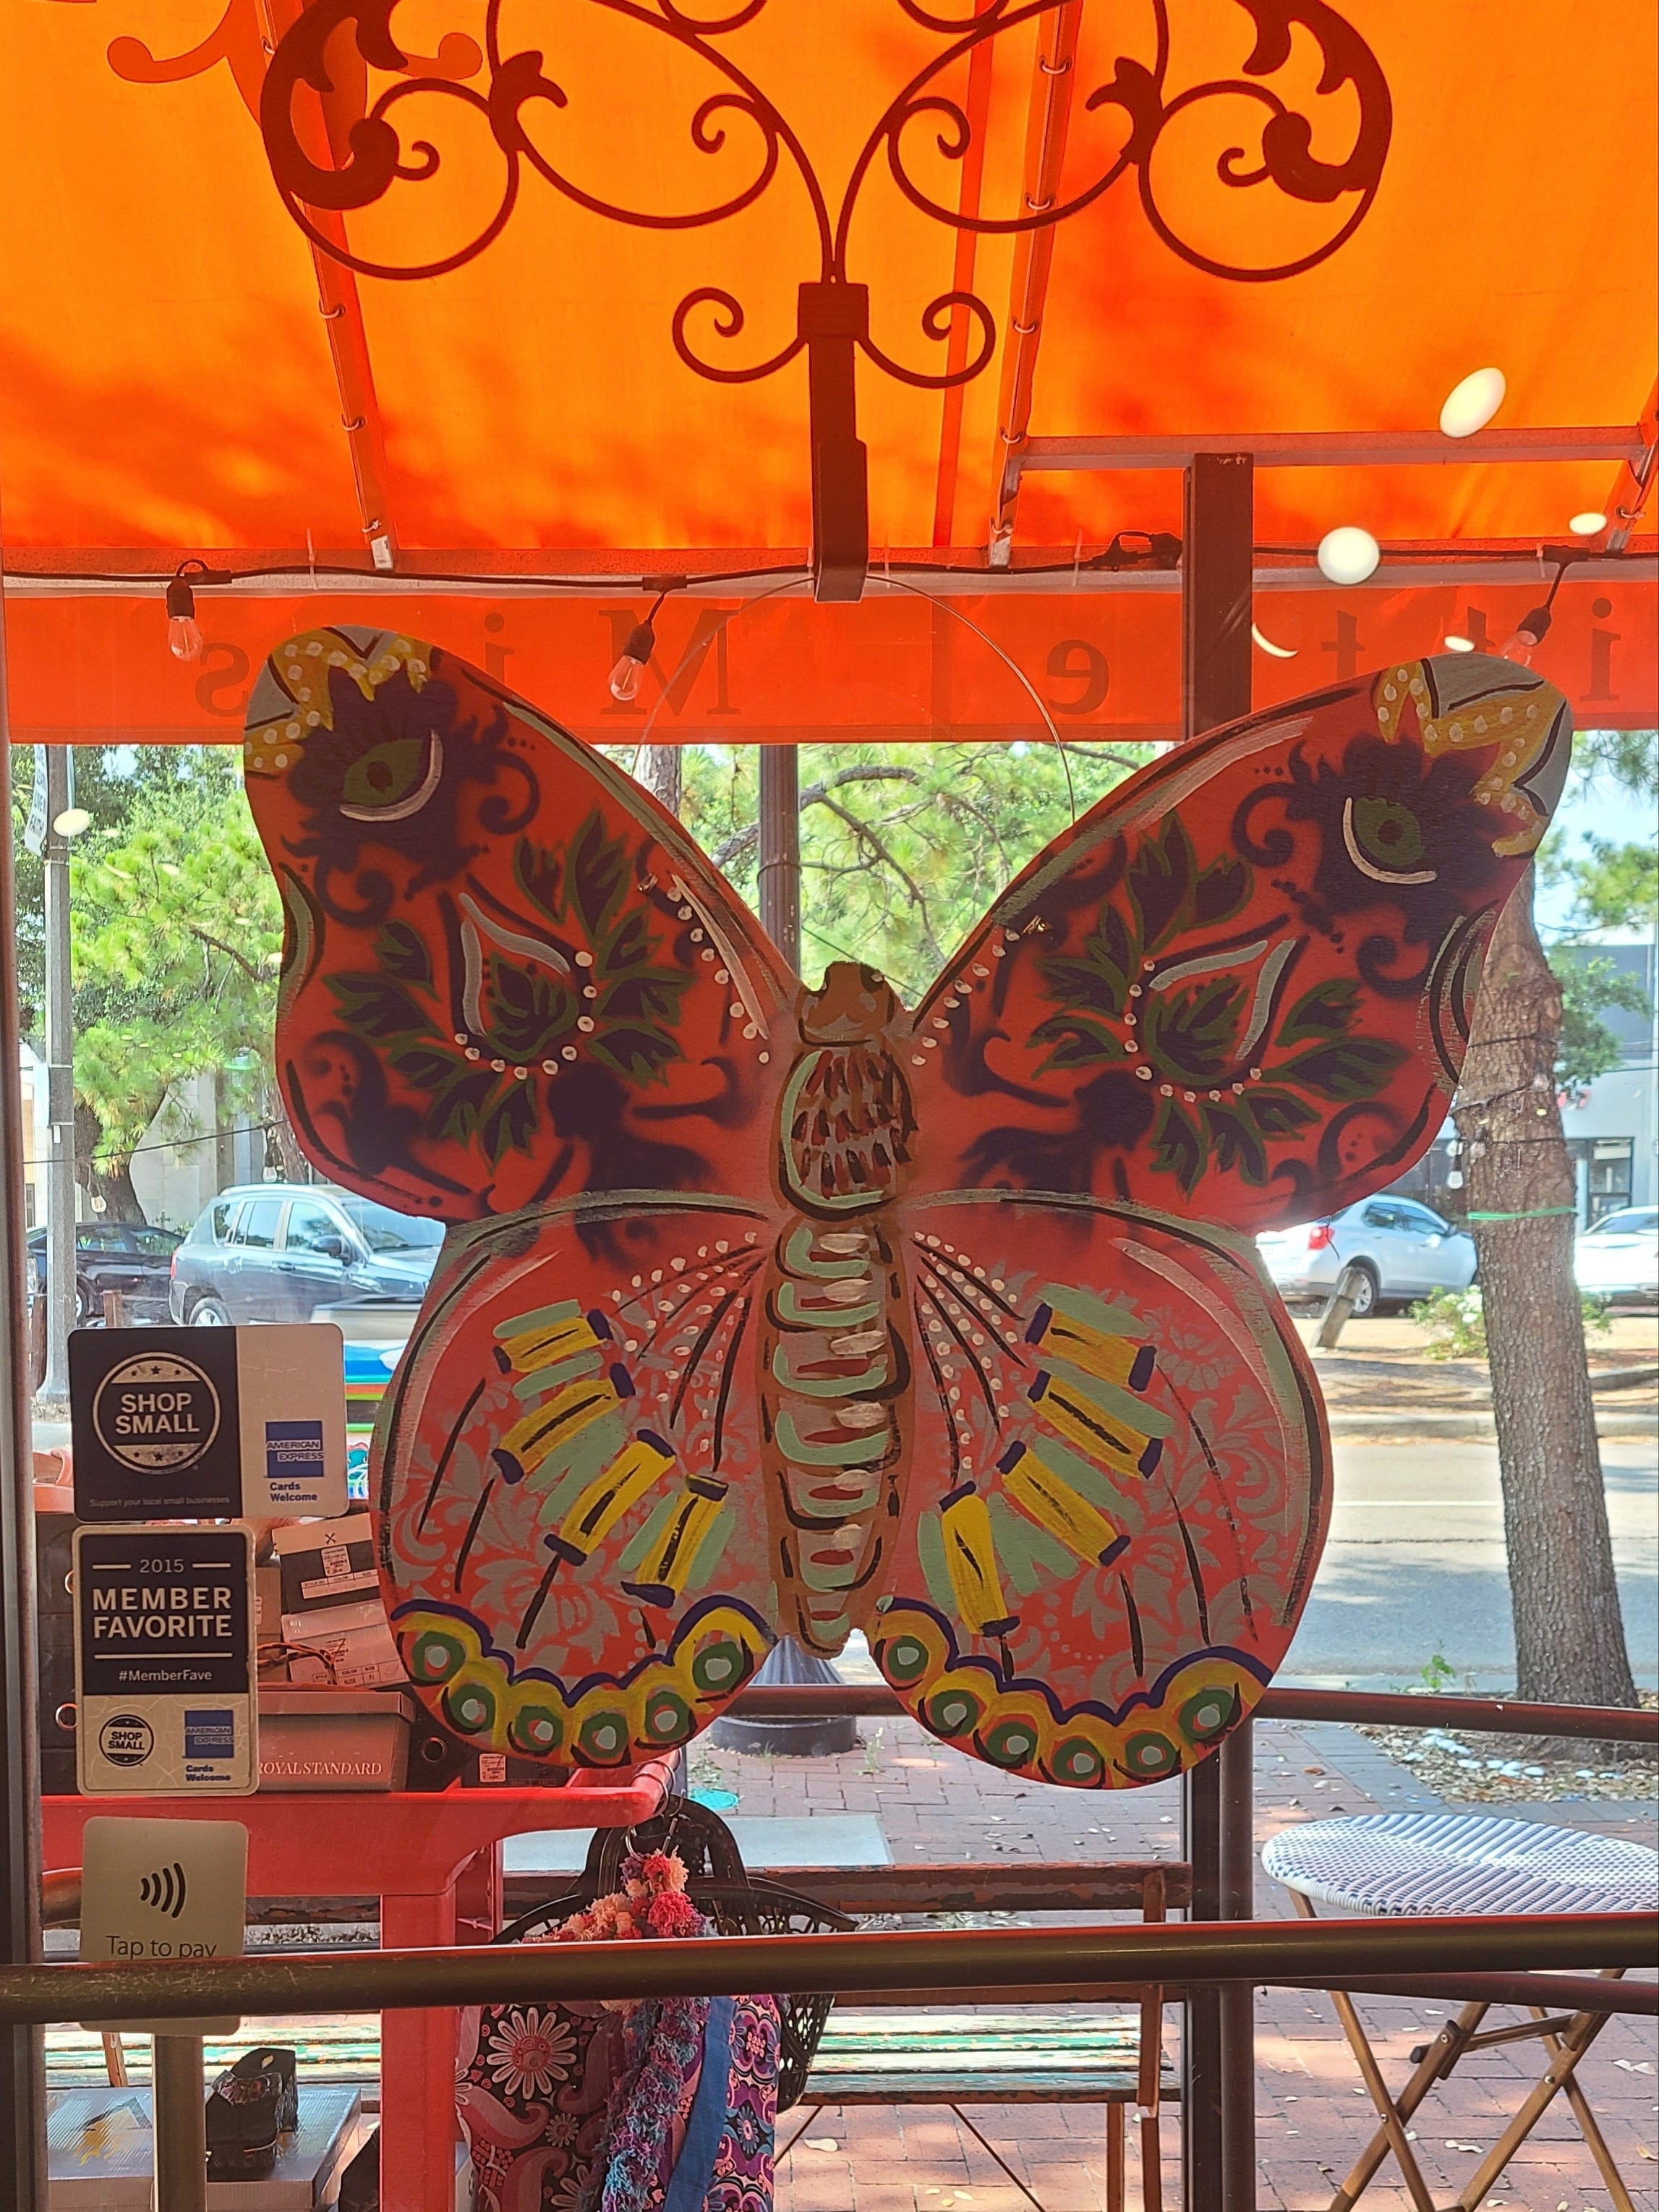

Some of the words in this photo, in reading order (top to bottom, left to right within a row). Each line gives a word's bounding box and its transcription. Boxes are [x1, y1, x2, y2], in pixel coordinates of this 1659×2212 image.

[120, 1392, 192, 1413] SHOP
[114, 1413, 200, 1435] SMALL
[270, 1481, 301, 1491] Cards
[89, 1498, 123, 1507] Support
[124, 1499, 141, 1507] your
[186, 1496, 230, 1505] businesses
[270, 1492, 317, 1502] Welcome
[140, 1559, 184, 1573] 2015
[93, 1586, 231, 1611] MEMBER
[93, 1614, 232, 1638] FAVORITE
[119, 1669, 213, 1682] #MemberFave
[111, 1731, 142, 1740] SHOP
[108, 1740, 145, 1750] SMALL
[302, 1762, 383, 1775] STANDARD
[106, 1935, 143, 1960] Tap
[150, 1939, 172, 1955] to
[179, 1942, 217, 1958] pay
